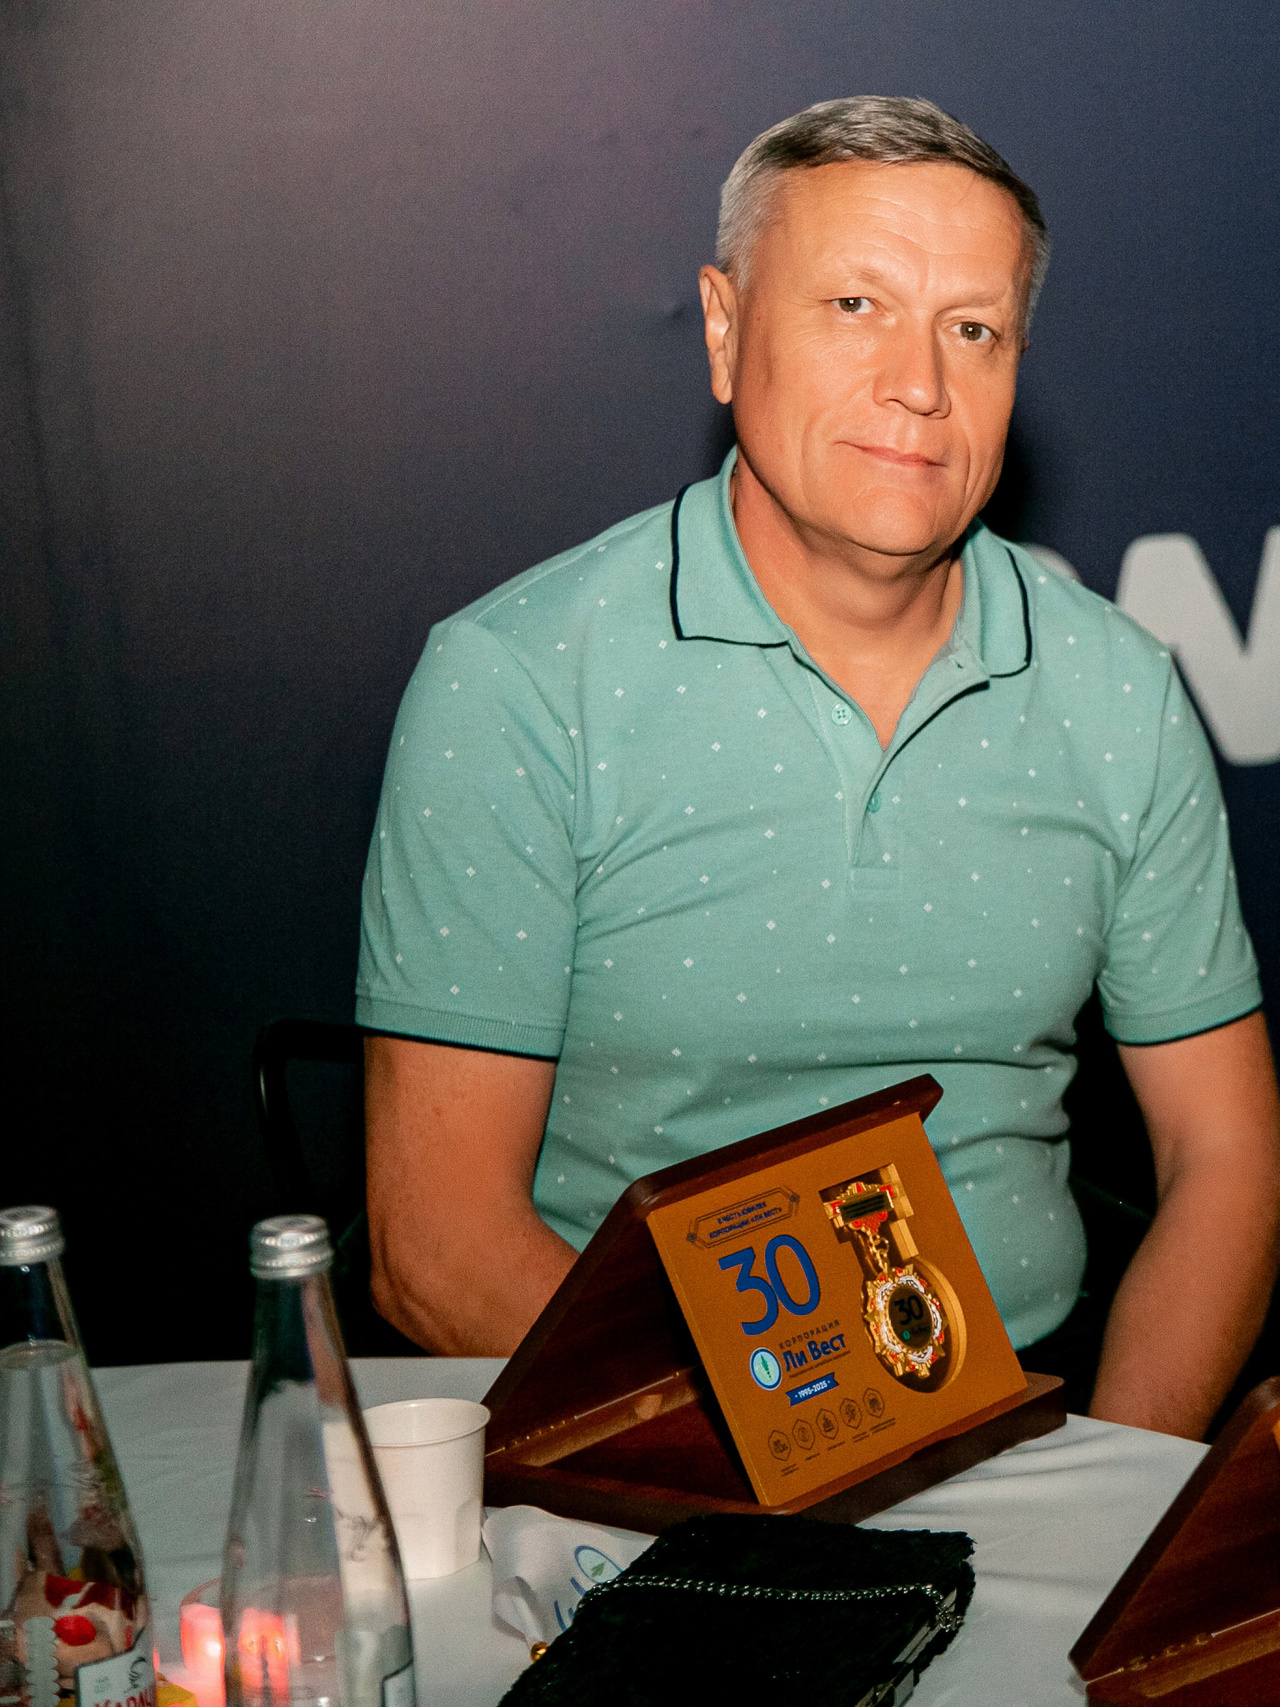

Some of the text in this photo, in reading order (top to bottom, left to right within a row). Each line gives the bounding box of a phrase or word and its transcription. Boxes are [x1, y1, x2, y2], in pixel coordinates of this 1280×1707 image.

[718, 1235, 820, 1335] 30
[894, 1295, 923, 1325] 30
[779, 1319, 840, 1350] КОРПОРАЦИЯ
[782, 1350, 808, 1372] Ли
[806, 1333, 846, 1361] Вест
